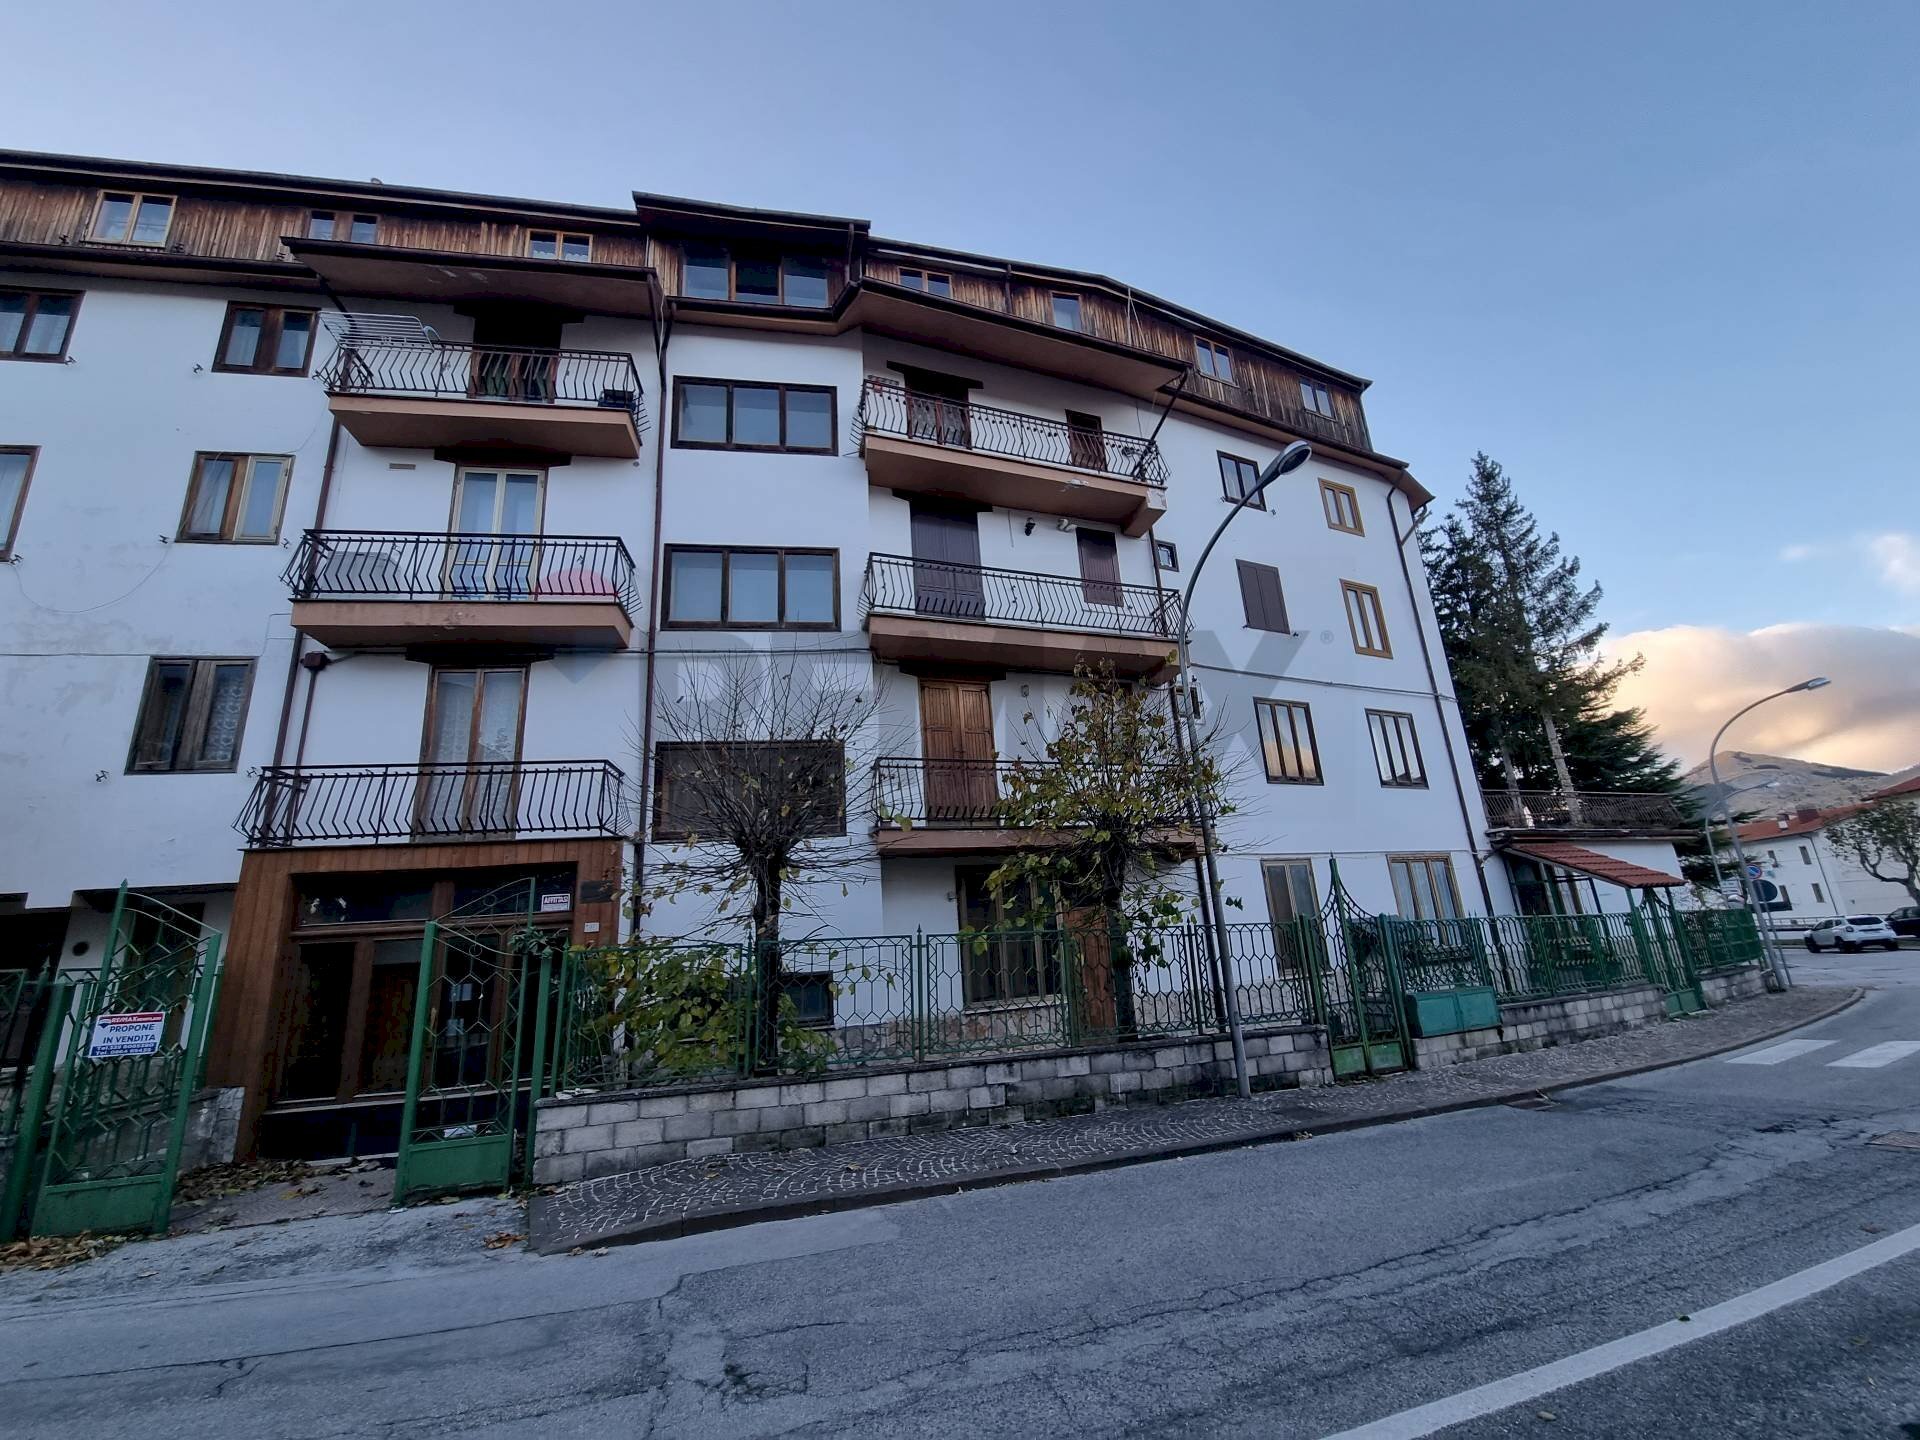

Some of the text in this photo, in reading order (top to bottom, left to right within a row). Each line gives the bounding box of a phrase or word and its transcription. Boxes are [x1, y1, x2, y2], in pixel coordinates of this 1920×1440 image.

[109, 1023, 155, 1033] PROPONE
[103, 1034, 156, 1044] IN VENDITA
